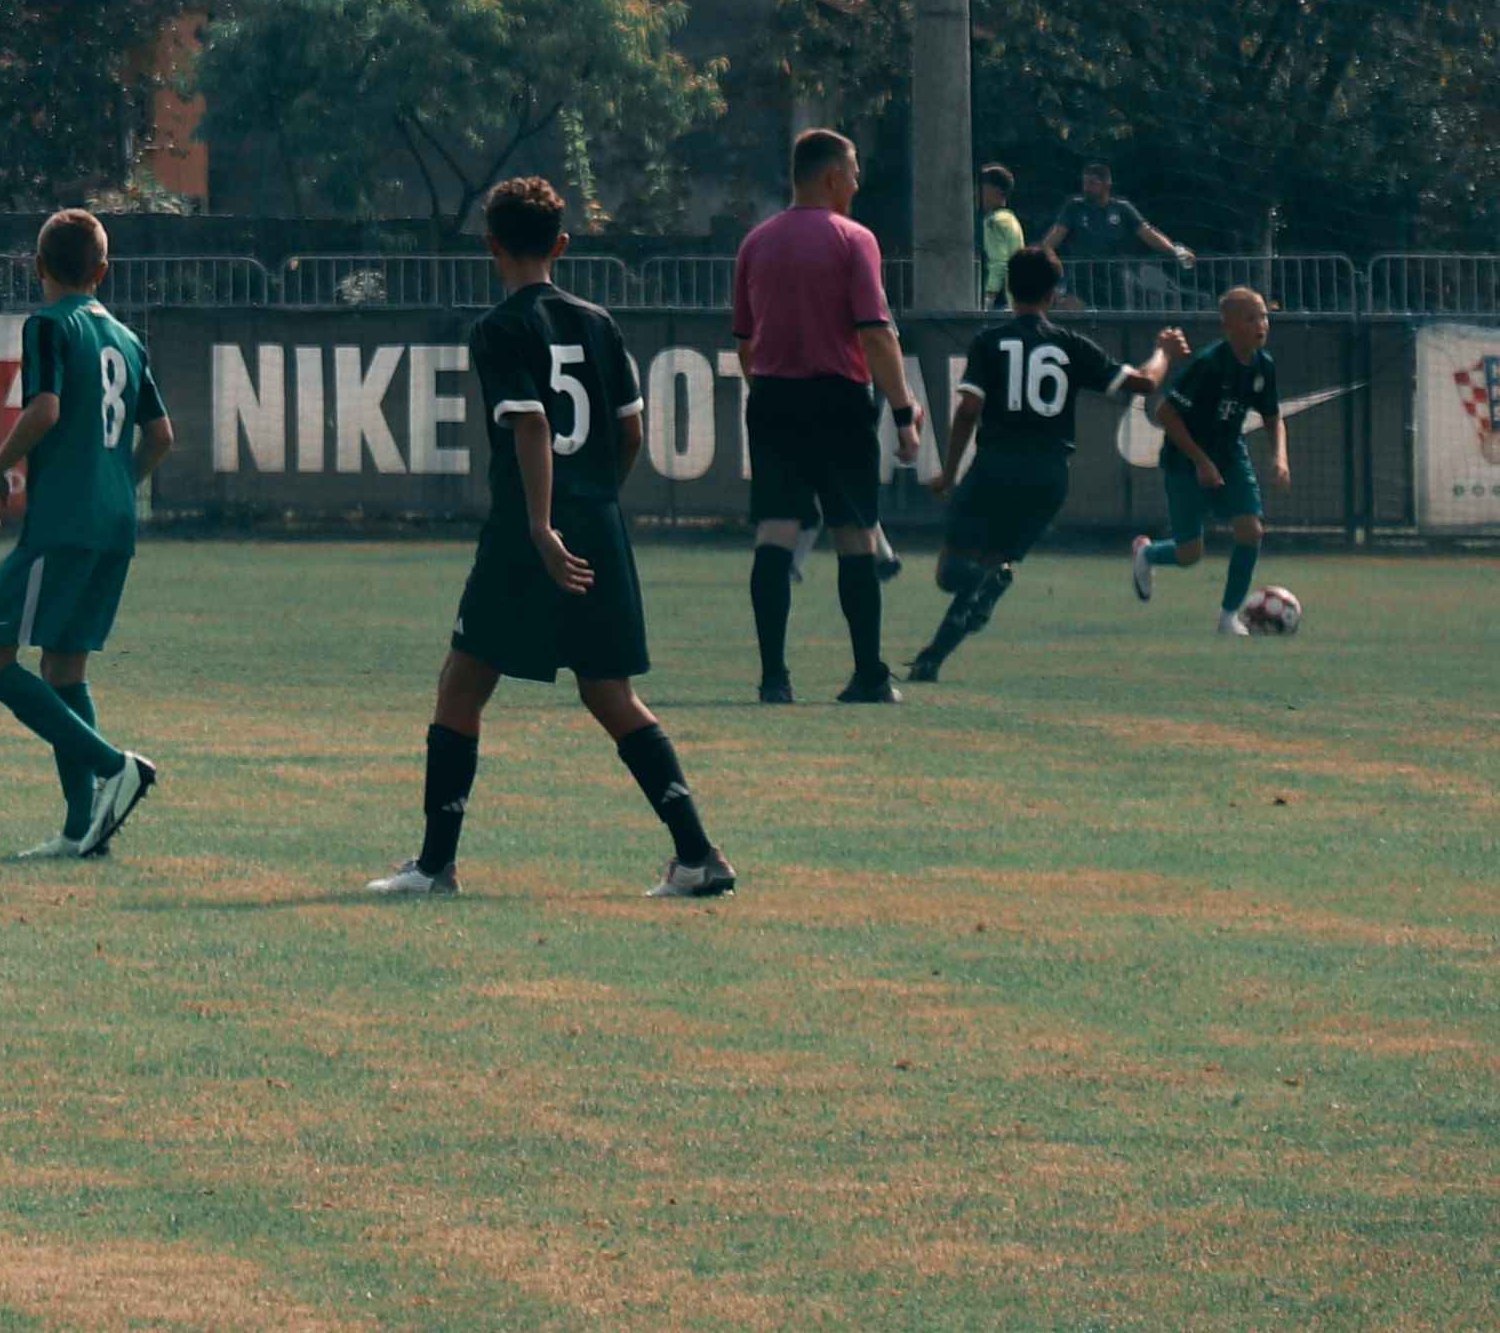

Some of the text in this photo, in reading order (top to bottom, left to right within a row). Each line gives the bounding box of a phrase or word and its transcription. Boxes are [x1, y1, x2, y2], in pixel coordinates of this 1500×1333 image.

[101, 346, 127, 448] 8
[212, 343, 470, 475] NIKE
[550, 344, 590, 455] 5
[1000, 340, 1070, 417] 16
